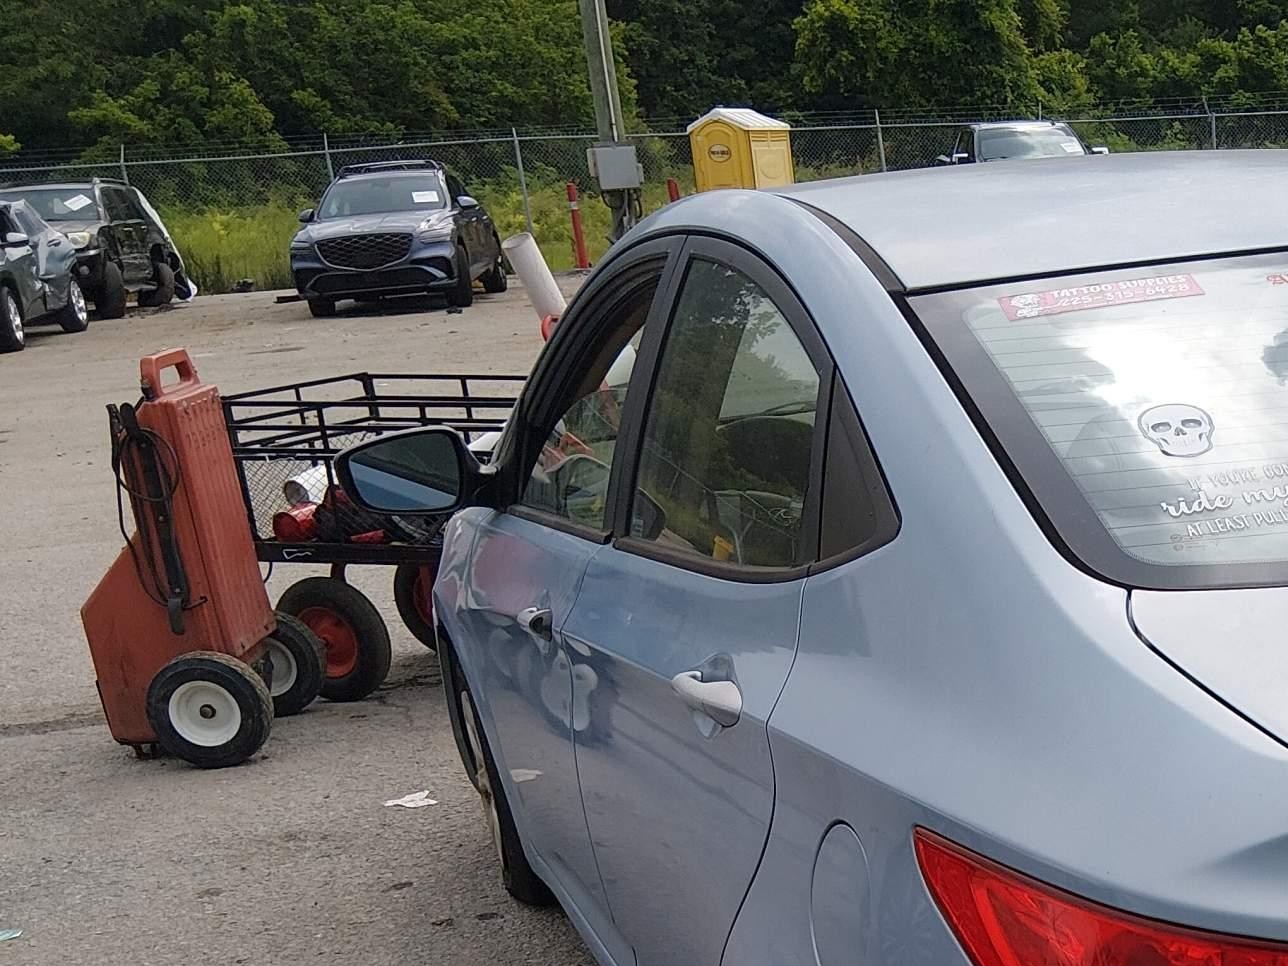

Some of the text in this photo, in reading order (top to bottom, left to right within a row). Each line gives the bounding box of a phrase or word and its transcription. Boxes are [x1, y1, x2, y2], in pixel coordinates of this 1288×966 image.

[1053, 275, 1186, 298] TATTOO SUPPLIES
[1160, 490, 1234, 517] ride
[1186, 523, 1204, 538] AT
[1207, 515, 1251, 535] LEAST
